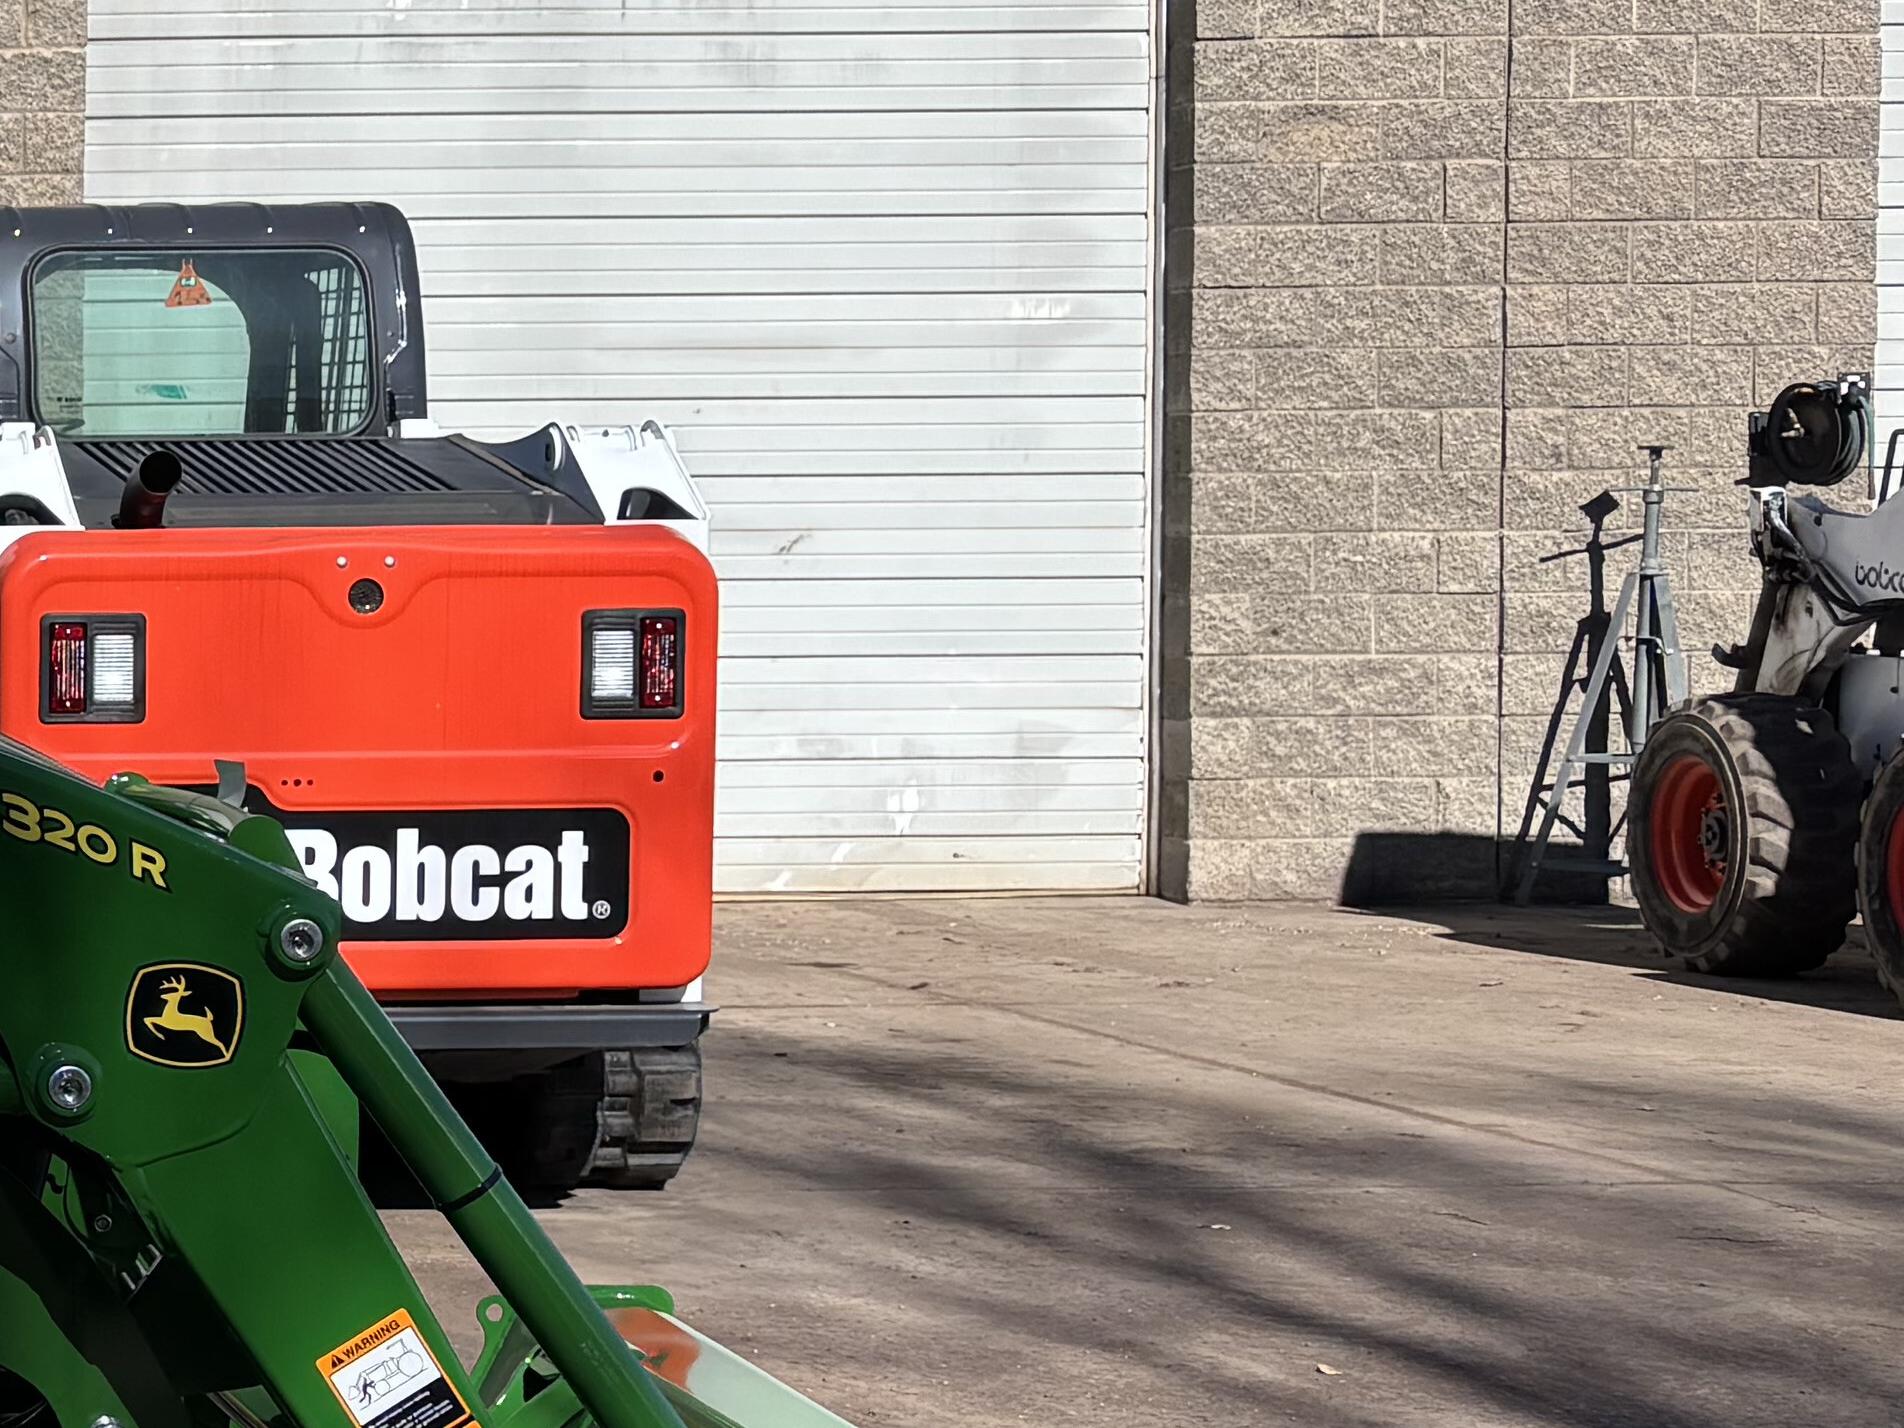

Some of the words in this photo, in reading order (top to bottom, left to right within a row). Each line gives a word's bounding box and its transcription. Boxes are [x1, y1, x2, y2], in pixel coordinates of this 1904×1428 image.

[2, 793, 117, 863] 320
[132, 841, 167, 888] R
[342, 1319, 401, 1361] WARNING
